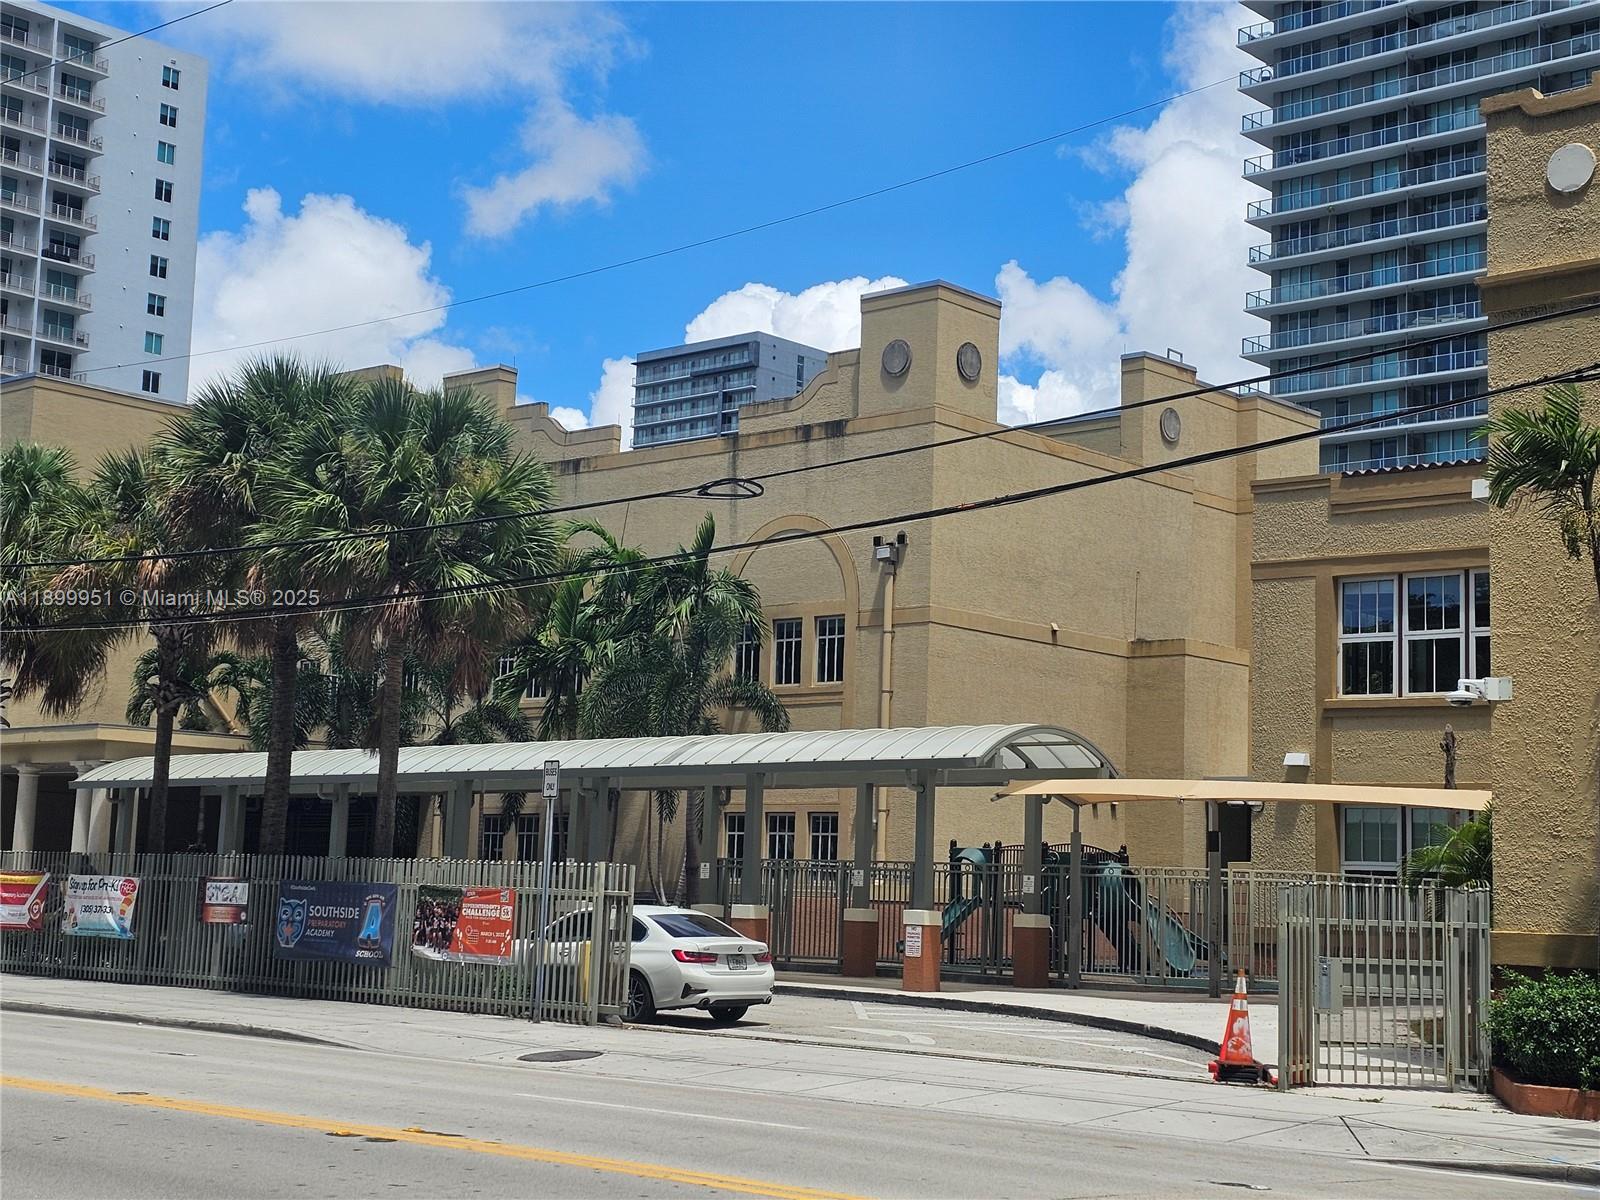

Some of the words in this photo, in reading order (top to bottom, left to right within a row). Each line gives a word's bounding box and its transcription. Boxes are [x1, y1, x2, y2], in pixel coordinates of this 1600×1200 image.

[545, 767, 557, 776] BUSES
[545, 782, 556, 791] ONLY
[309, 906, 360, 919] SOUTHSIDE
[462, 908, 500, 917] CHALLENGE
[307, 920, 346, 929] PREPARATORY
[305, 929, 335, 937] ACADEMY
[355, 950, 384, 959] SCHOOL
